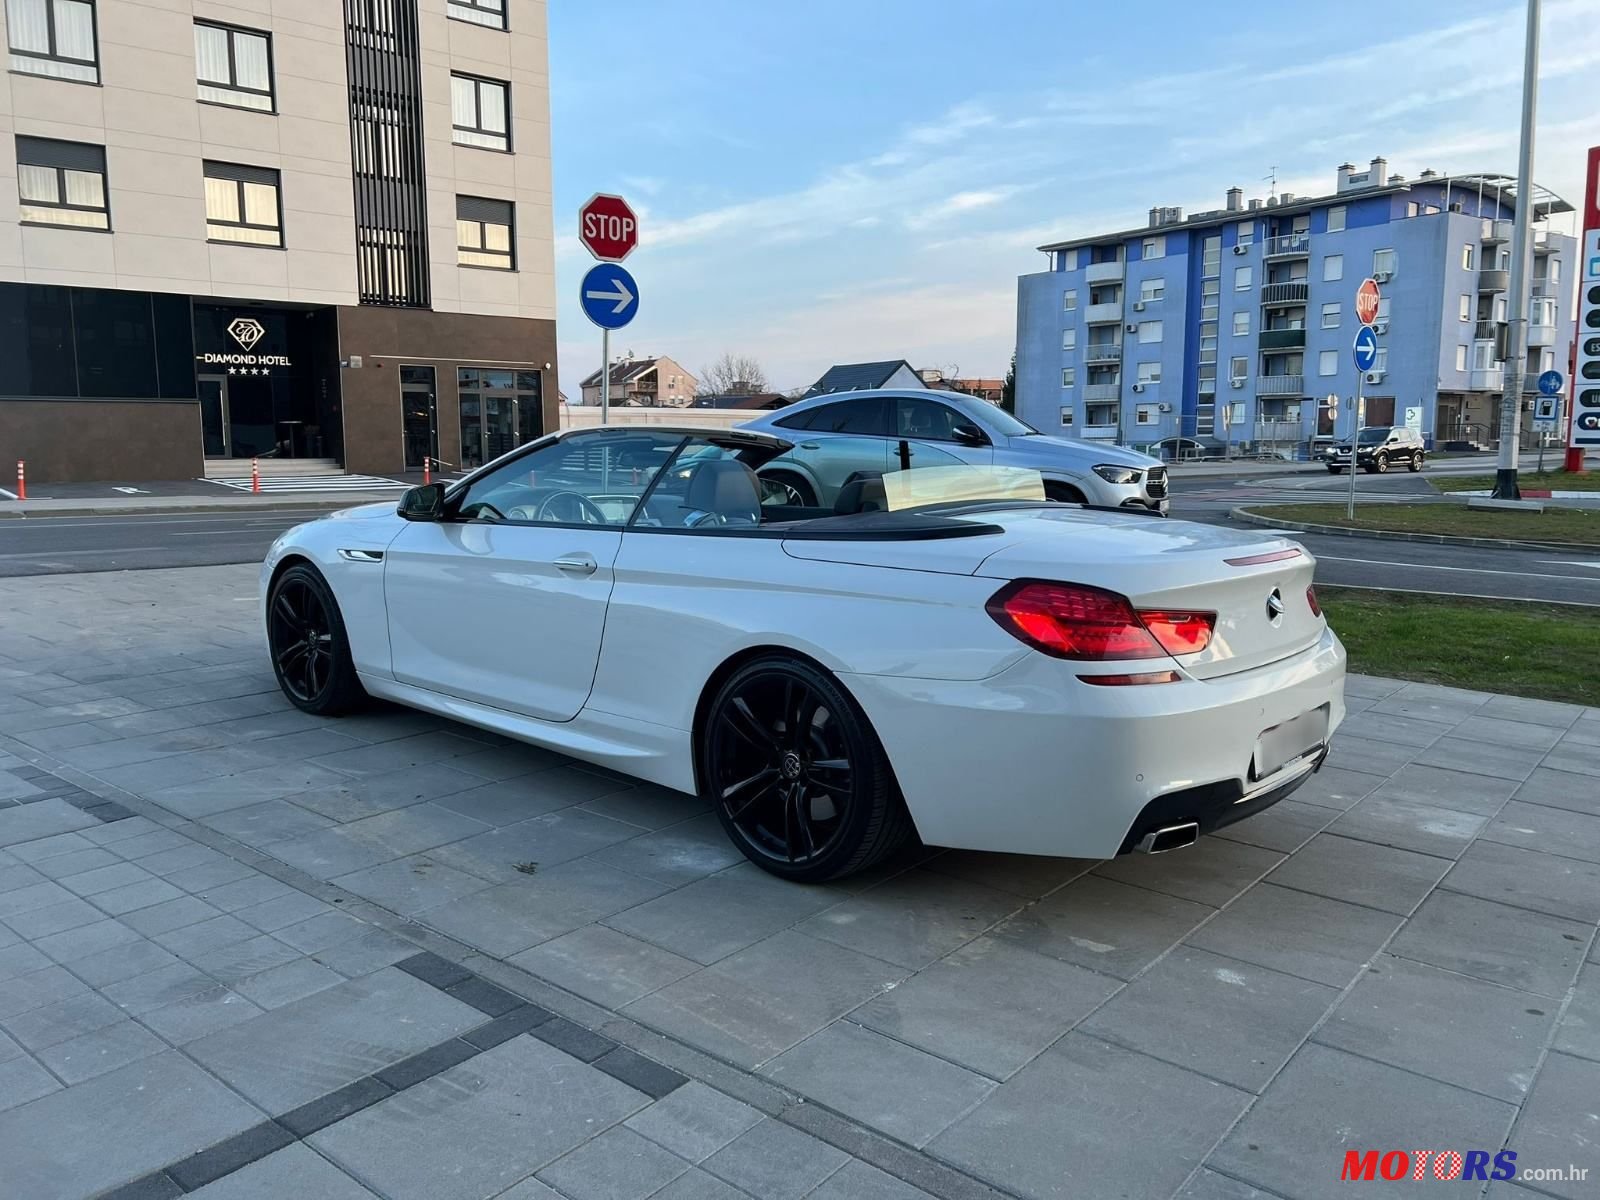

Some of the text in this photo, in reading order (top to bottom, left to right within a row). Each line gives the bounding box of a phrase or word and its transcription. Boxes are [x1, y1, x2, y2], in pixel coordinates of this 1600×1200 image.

[584, 212, 635, 242] STOP
[1358, 293, 1379, 312] STOP
[204, 353, 292, 366] DIAMOND HOTEL
